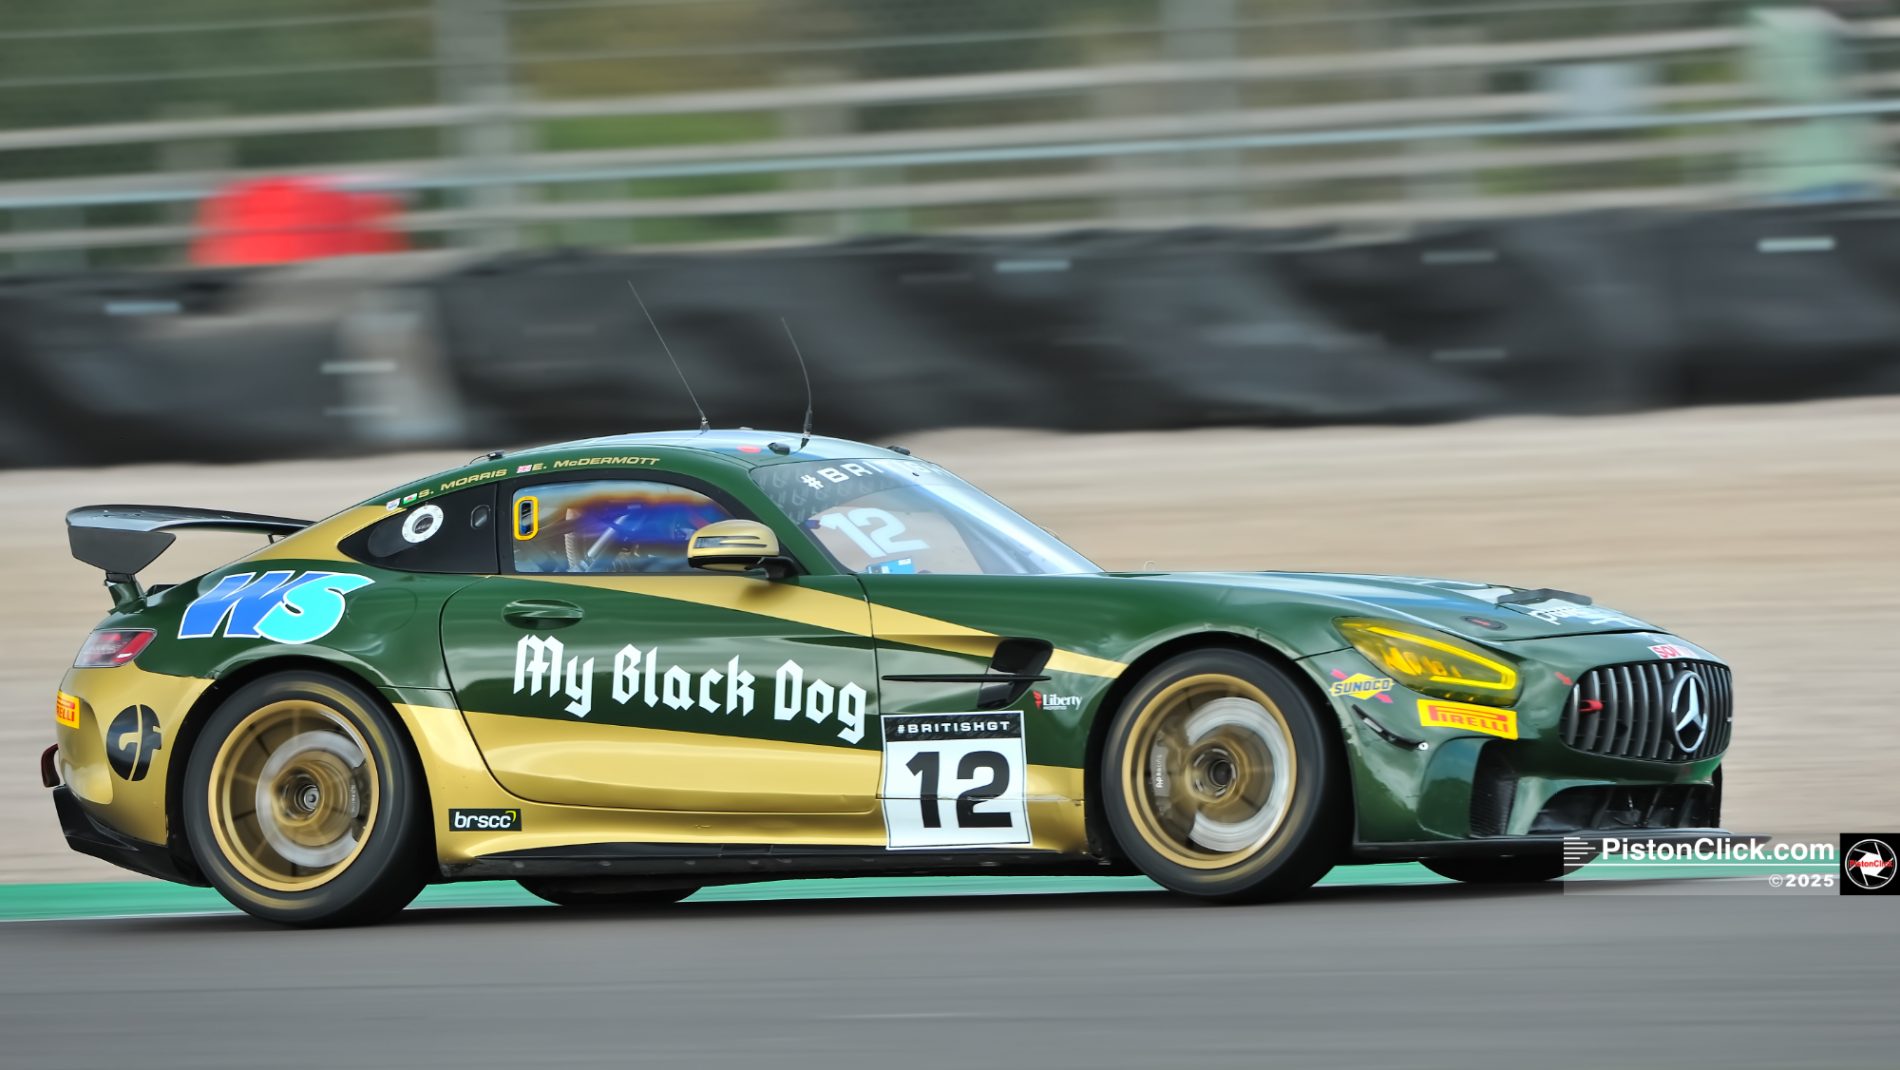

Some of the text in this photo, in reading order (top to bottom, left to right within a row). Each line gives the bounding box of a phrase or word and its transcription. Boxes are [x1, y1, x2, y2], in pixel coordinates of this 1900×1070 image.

[531, 456, 661, 472] E. McDERMOTT
[418, 468, 508, 499] S. MORRIS
[819, 507, 931, 559] 12
[177, 569, 376, 645] WS
[513, 633, 867, 745] My Black Dog
[1042, 693, 1083, 710] Liberty
[1333, 678, 1391, 695] SUNOCO
[897, 721, 1011, 735] #BRITISHGT
[1428, 704, 1510, 734] PIRELLI
[905, 750, 1013, 829] 12
[454, 811, 512, 829] brscc
